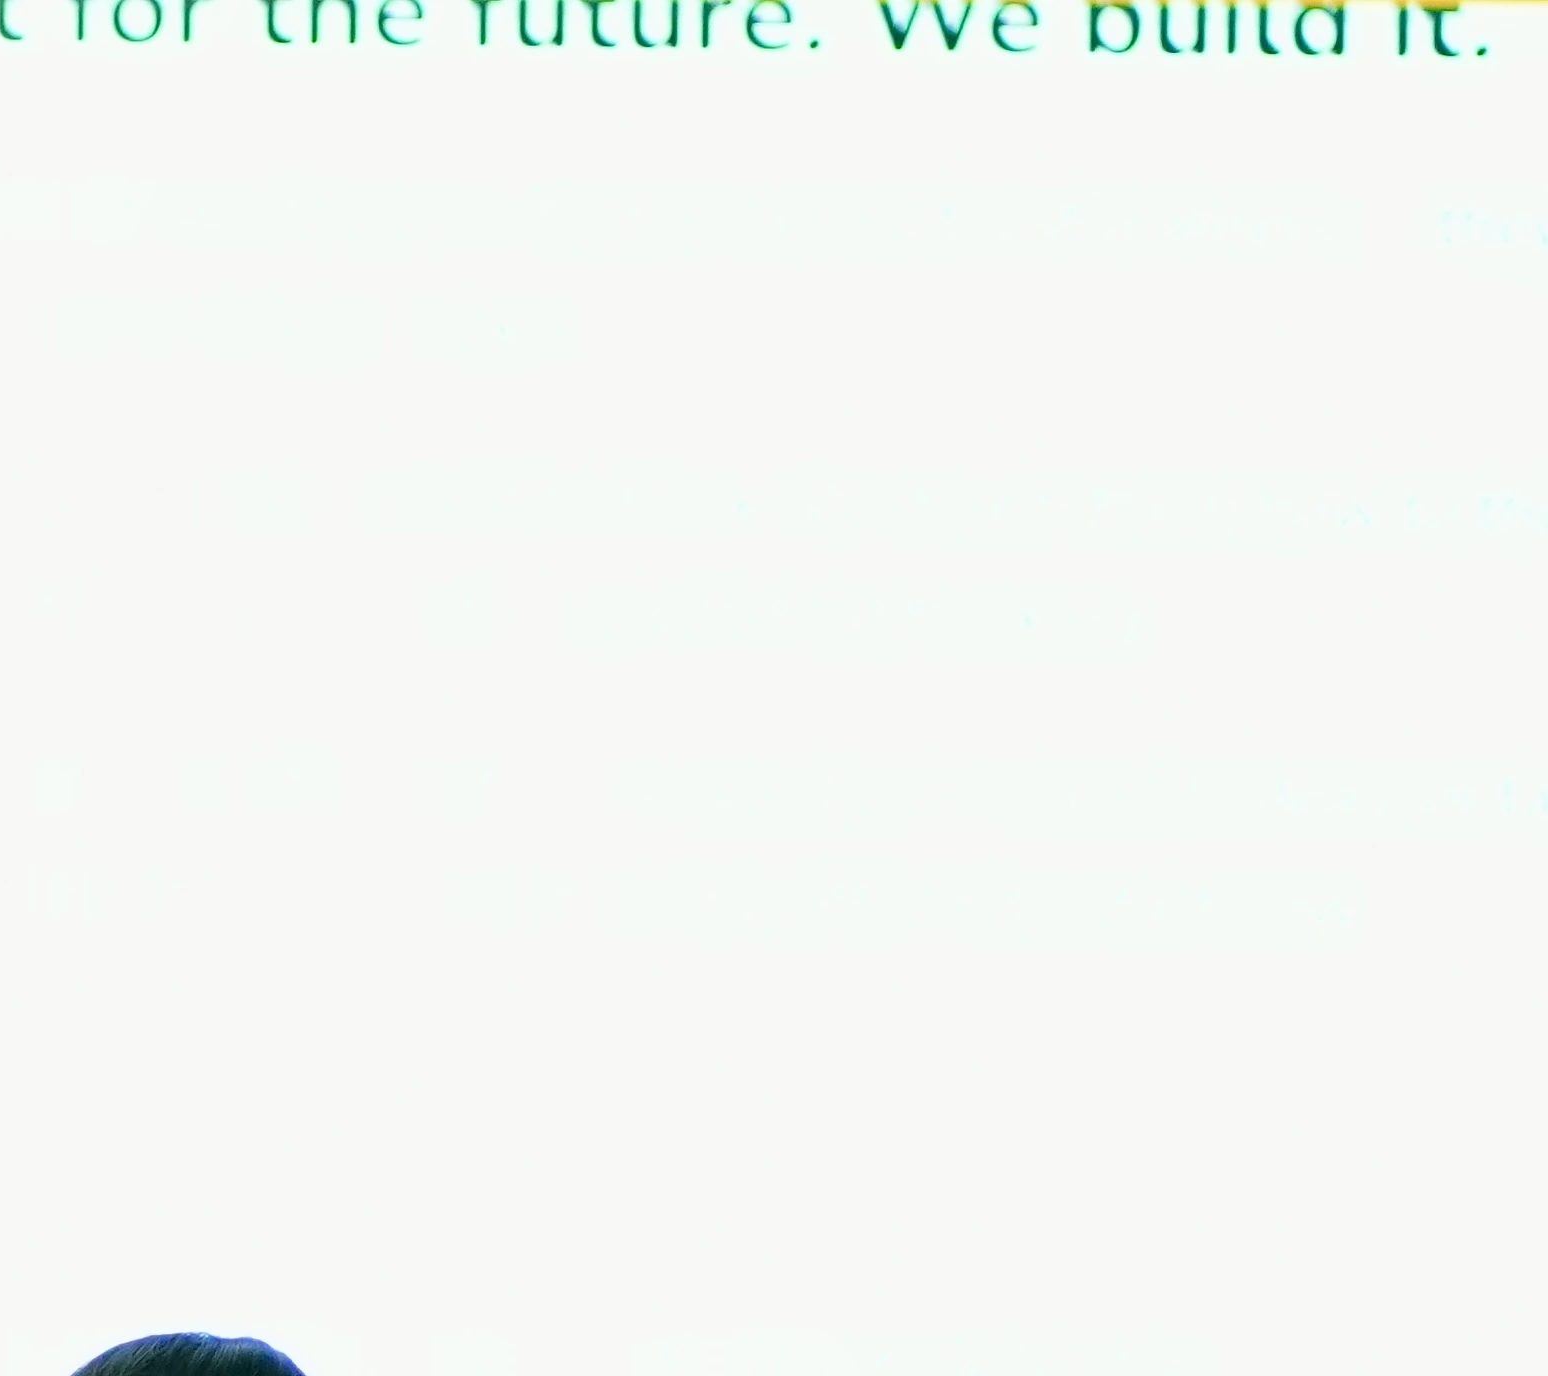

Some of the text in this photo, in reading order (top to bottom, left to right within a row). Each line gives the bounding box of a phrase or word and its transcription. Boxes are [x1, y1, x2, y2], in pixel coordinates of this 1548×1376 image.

[258, 0, 426, 46] the
[470, 0, 822, 50] future.
[876, 0, 1043, 52] We
[1087, 0, 1349, 56] build
